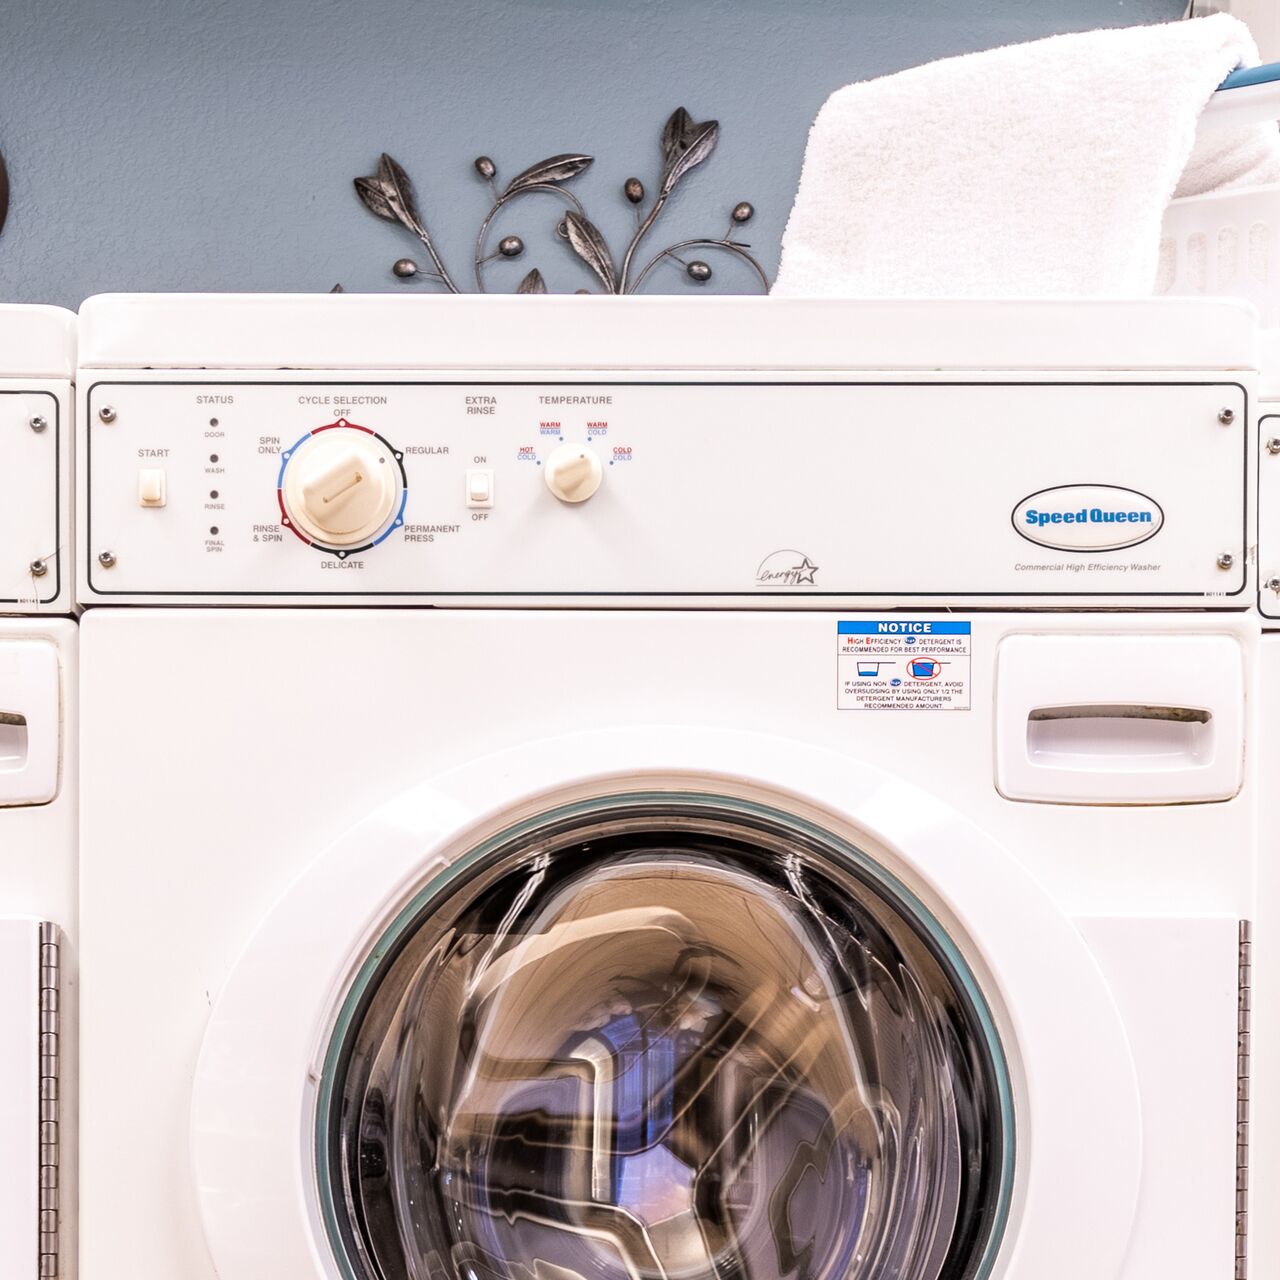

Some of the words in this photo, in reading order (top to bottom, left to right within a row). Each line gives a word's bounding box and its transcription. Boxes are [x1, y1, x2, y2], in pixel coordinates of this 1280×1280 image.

[197, 396, 233, 404] STATUS
[298, 396, 330, 404] CYCLE
[333, 396, 387, 404] SELECTION
[465, 396, 497, 404] EXTRA
[539, 396, 612, 404] TEMPERATURE
[334, 409, 351, 417] OFF
[467, 406, 495, 414] RINSE
[260, 437, 280, 445] SPIN
[138, 449, 169, 457] START
[258, 446, 281, 454] ONLY
[472, 512, 488, 521] OFF
[1026, 509, 1087, 527] Speed
[1090, 509, 1151, 523] Queen
[253, 525, 280, 533] RINSE
[404, 524, 460, 533] PERMANENT
[253, 534, 259, 542] &
[262, 534, 283, 542] SPIN
[404, 534, 434, 542] PRESS
[321, 561, 364, 569] DELICATE
[1014, 563, 1064, 571] Commercial
[1066, 564, 1085, 572] High
[1088, 564, 1128, 572] Efficiency
[1131, 563, 1160, 571] Washer
[878, 623, 931, 633] NOTICE
